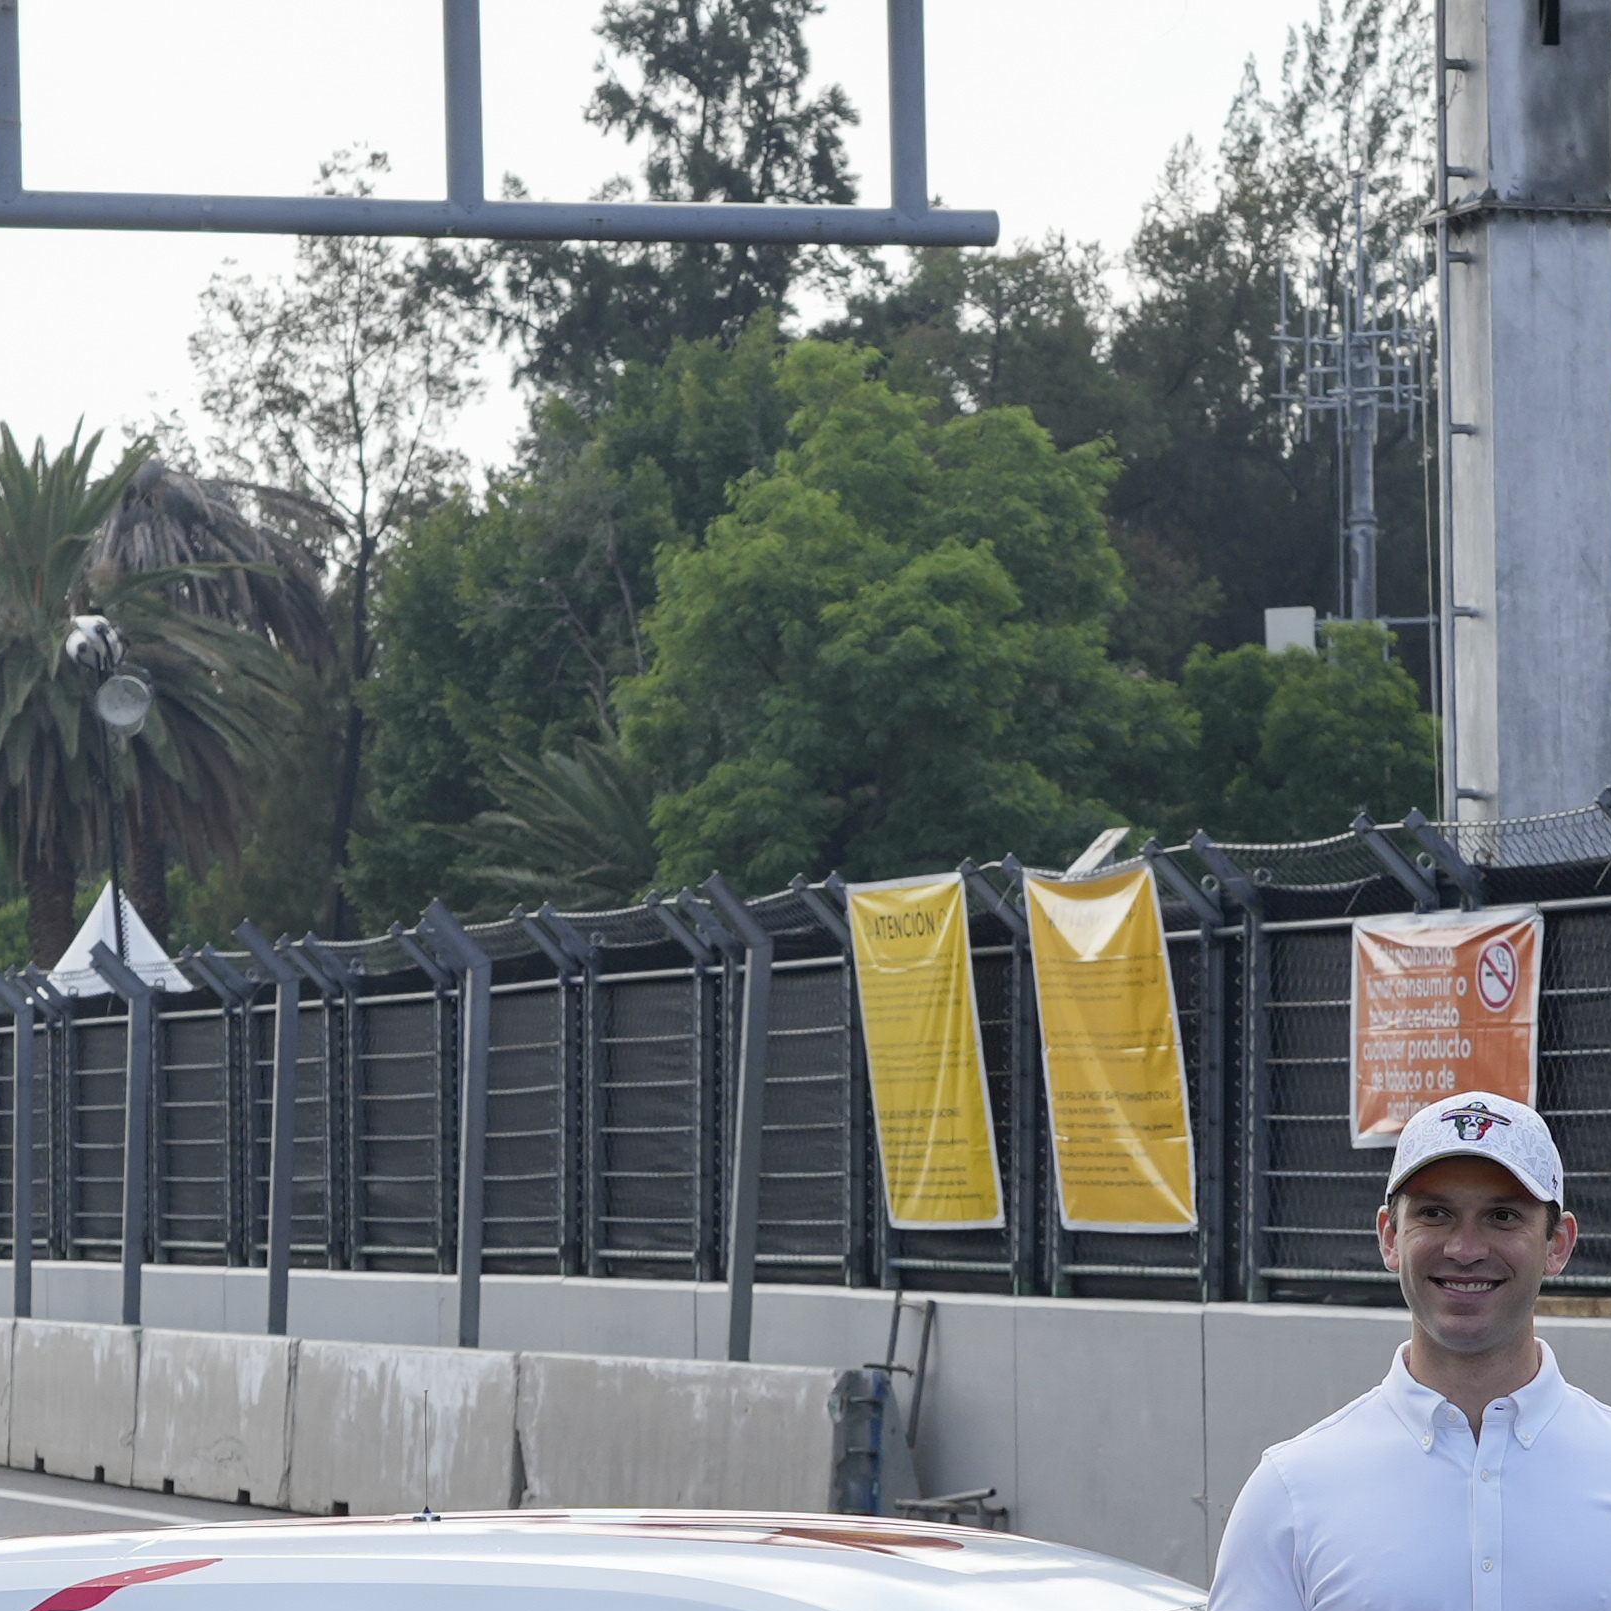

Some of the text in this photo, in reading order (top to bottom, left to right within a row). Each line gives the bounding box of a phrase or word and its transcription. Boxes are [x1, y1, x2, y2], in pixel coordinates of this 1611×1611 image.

[875, 904, 936, 940] ATENCIÓN
[1395, 976, 1453, 998] consumir
[1456, 976, 1468, 998] o
[1408, 1030, 1472, 1065] producto
[1425, 1070, 1435, 1090] o
[1437, 1064, 1456, 1090] de
